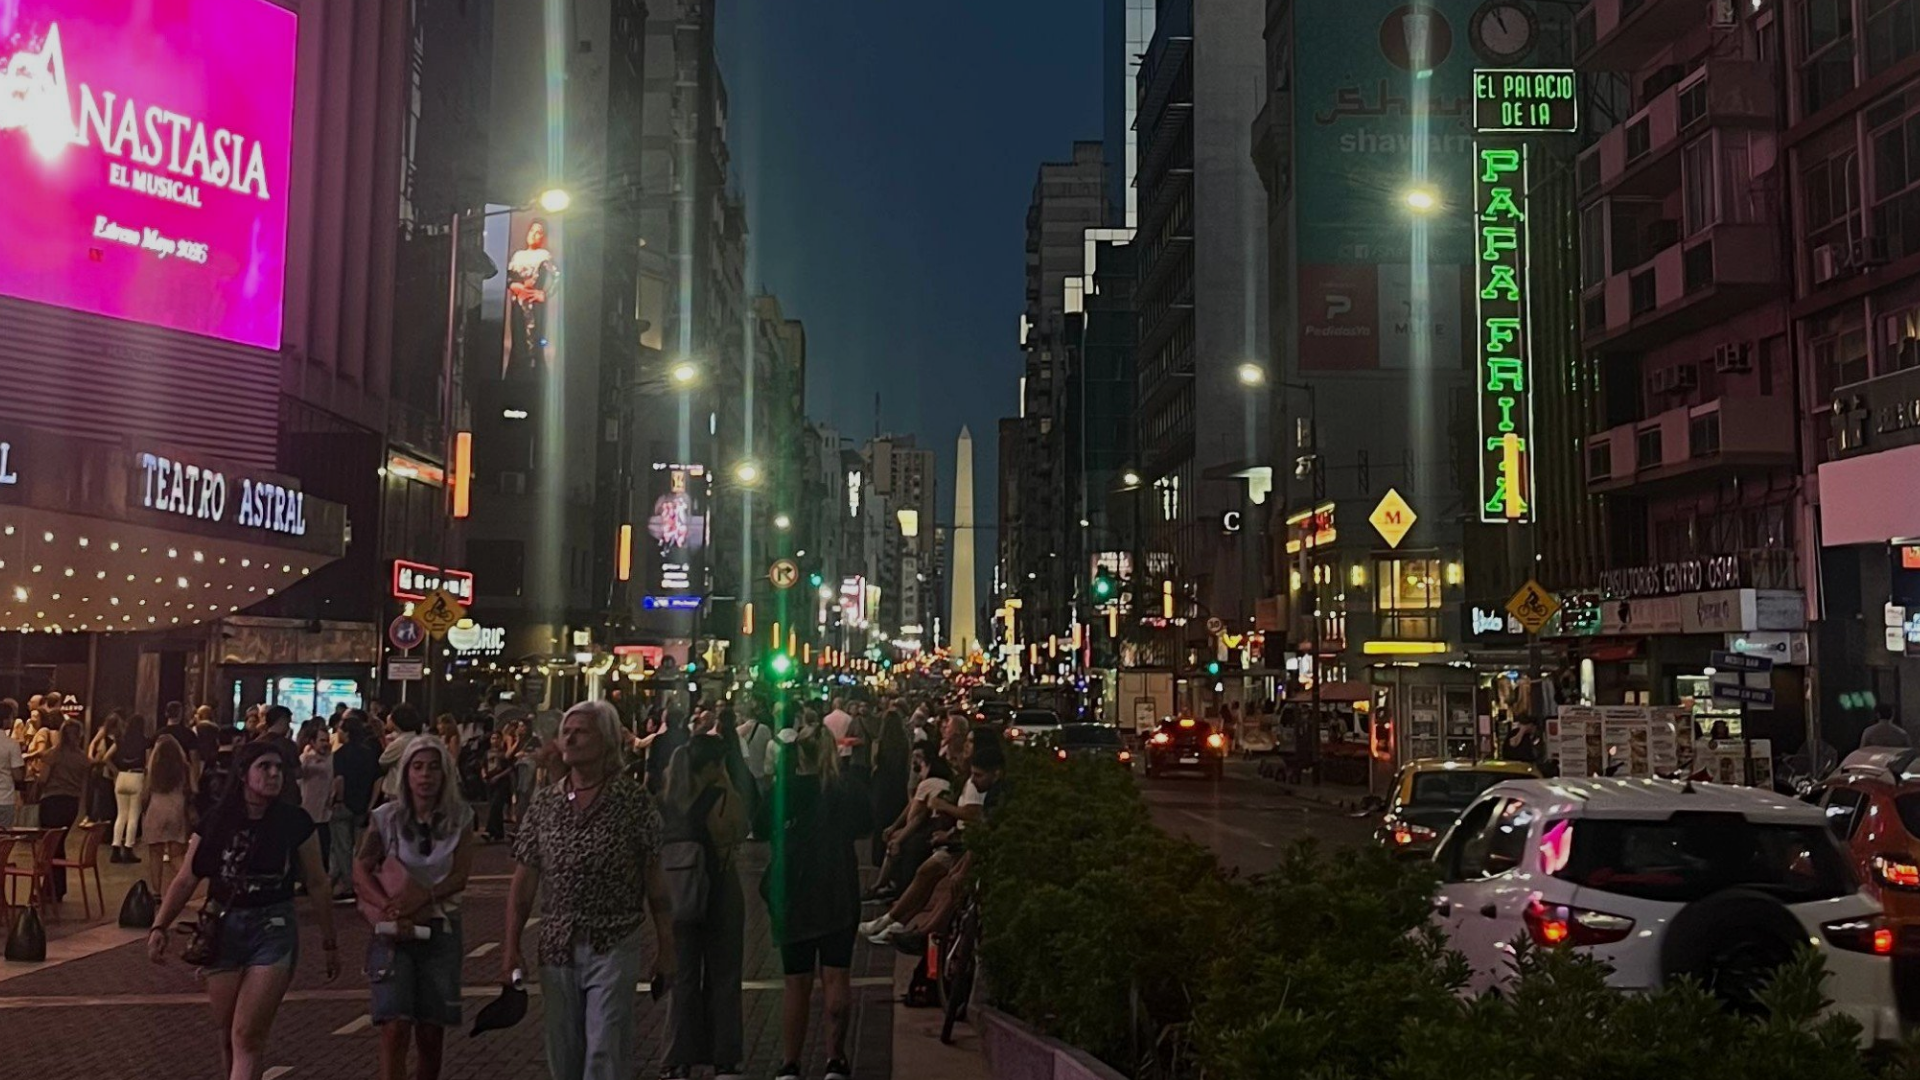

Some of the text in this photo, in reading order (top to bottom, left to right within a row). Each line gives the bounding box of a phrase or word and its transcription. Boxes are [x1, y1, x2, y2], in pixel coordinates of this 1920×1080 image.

[1477, 75, 1496, 99] EL
[33, 22, 271, 200] ANASTASIA
[1502, 101, 1524, 126] DE
[109, 162, 202, 208] EL MUSICAL
[141, 226, 176, 259] Mayo
[142, 452, 306, 536] TEATRO ASTRAL
[1663, 559, 1702, 593] CENTRO
